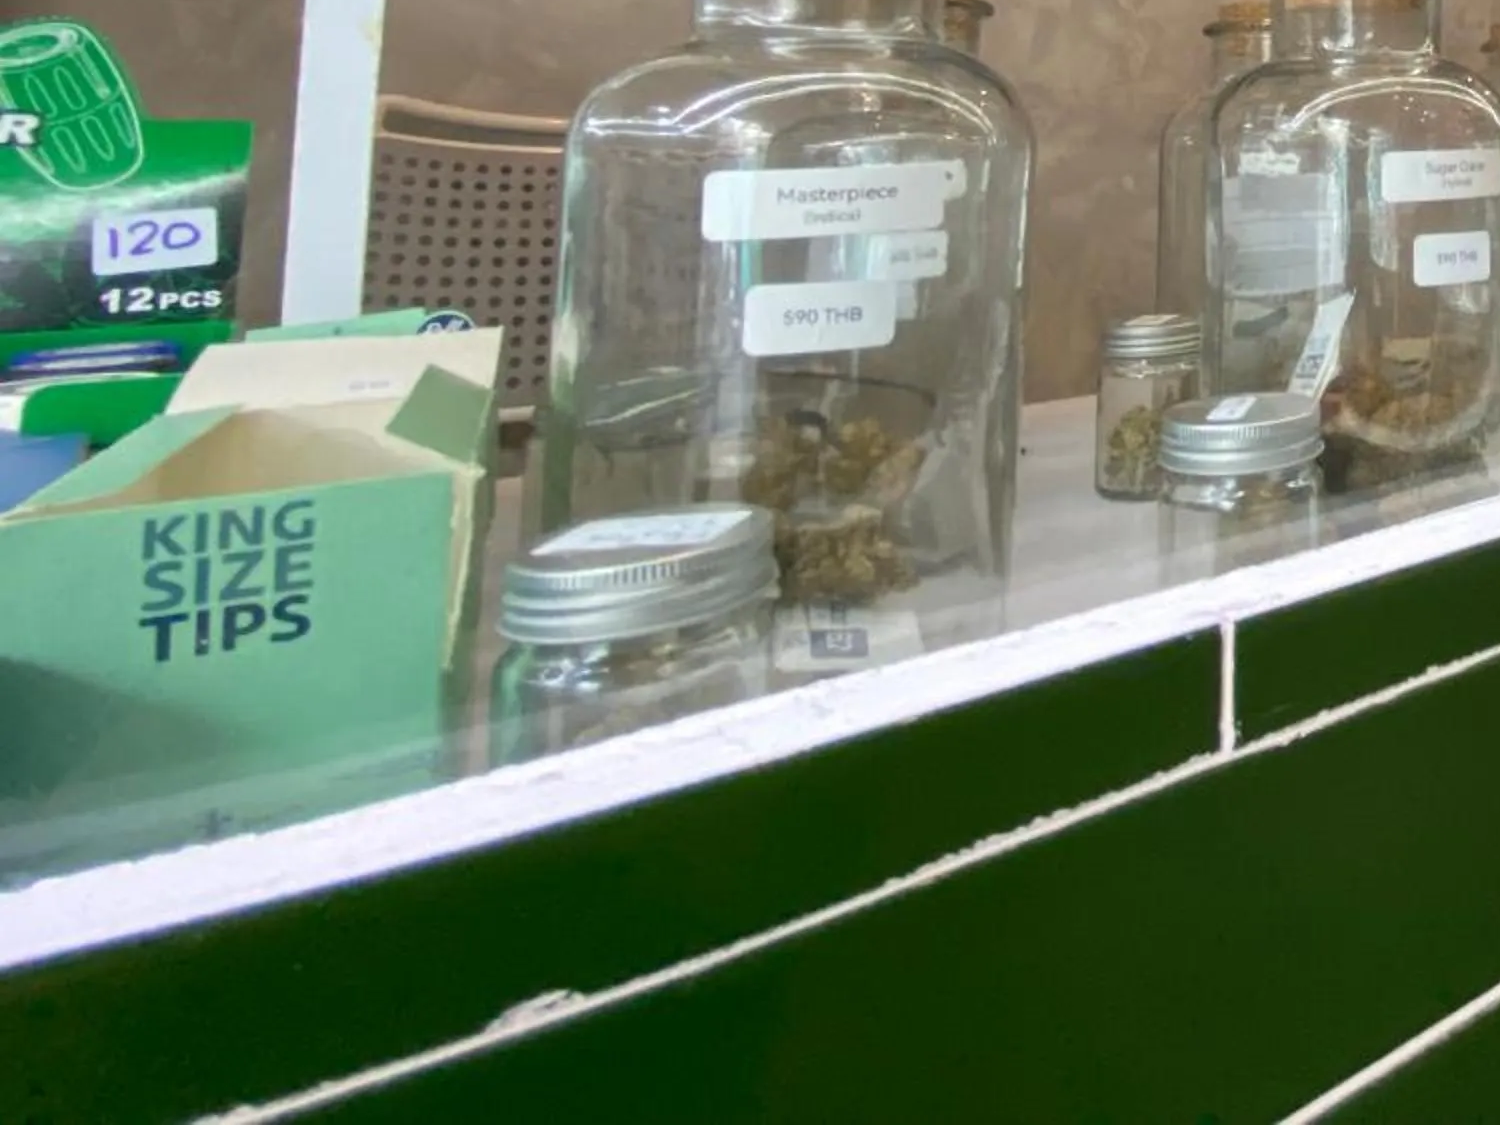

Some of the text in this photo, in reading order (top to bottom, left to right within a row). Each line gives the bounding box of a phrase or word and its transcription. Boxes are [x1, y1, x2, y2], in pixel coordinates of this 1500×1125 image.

[776, 185, 899, 205] Masterpiece
[107, 220, 201, 261] 120
[101, 286, 223, 314] 12 PCS
[824, 305, 864, 325] THB
[142, 499, 316, 561] KING
[140, 542, 315, 612] SIZE
[138, 593, 312, 663] TIPS
